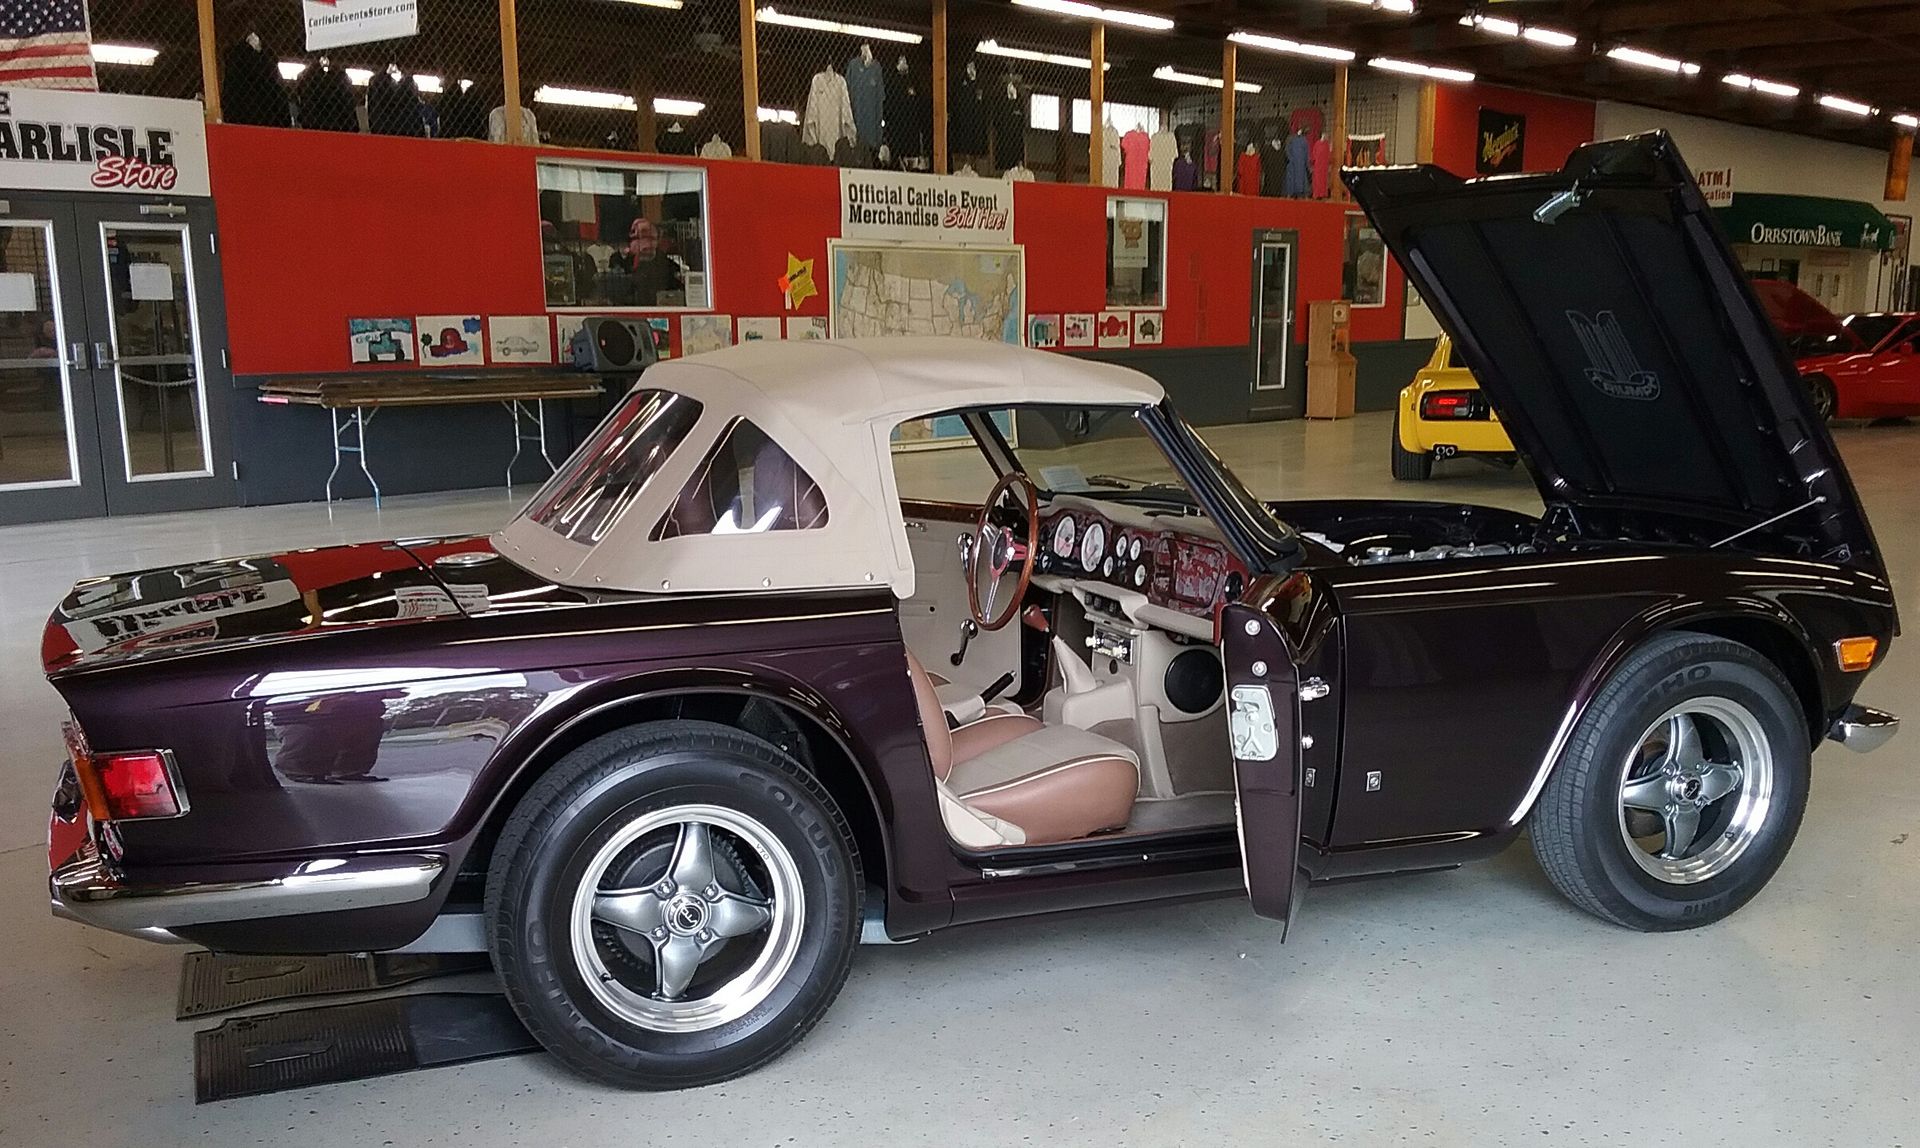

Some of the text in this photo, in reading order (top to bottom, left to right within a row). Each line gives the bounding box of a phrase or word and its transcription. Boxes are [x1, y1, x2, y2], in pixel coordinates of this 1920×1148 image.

[308, 3, 415, 28] CarlisleEventsStore.com
[91, 155, 178, 190] Store
[848, 183, 998, 211] Official Carlisle Event
[849, 204, 1009, 231] Merchandise Sold Here!
